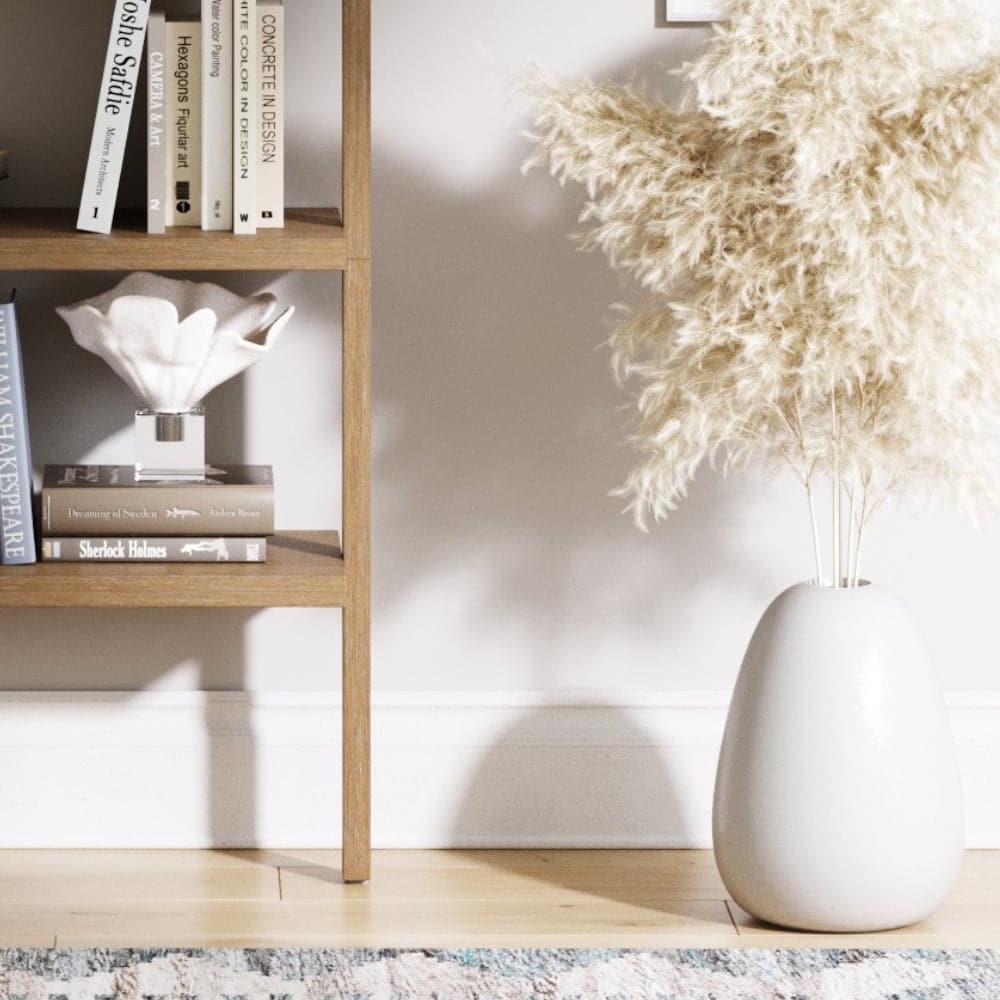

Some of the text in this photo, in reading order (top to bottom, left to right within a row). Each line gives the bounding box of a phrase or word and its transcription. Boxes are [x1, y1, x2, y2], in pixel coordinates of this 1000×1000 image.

[212, 22, 222, 42] color
[175, 36, 192, 102] Hexagons
[209, 44, 222, 77] Painting
[240, 35, 249, 92] COLOR
[105, 53, 137, 115] Safdie
[150, 52, 163, 146] CAMERA & Art
[240, 97, 249, 112] IN
[262, 14, 276, 163] CONCRETE IN DESIGN
[95, 126, 115, 196] Modern Architects
[178, 153, 190, 168] art
[240, 118, 249, 180] DESIGN
[150, 200, 160, 210] 2
[68, 508, 158, 519] Dreaming of Sweden
[79, 540, 167, 558] Sherlock Holmes
